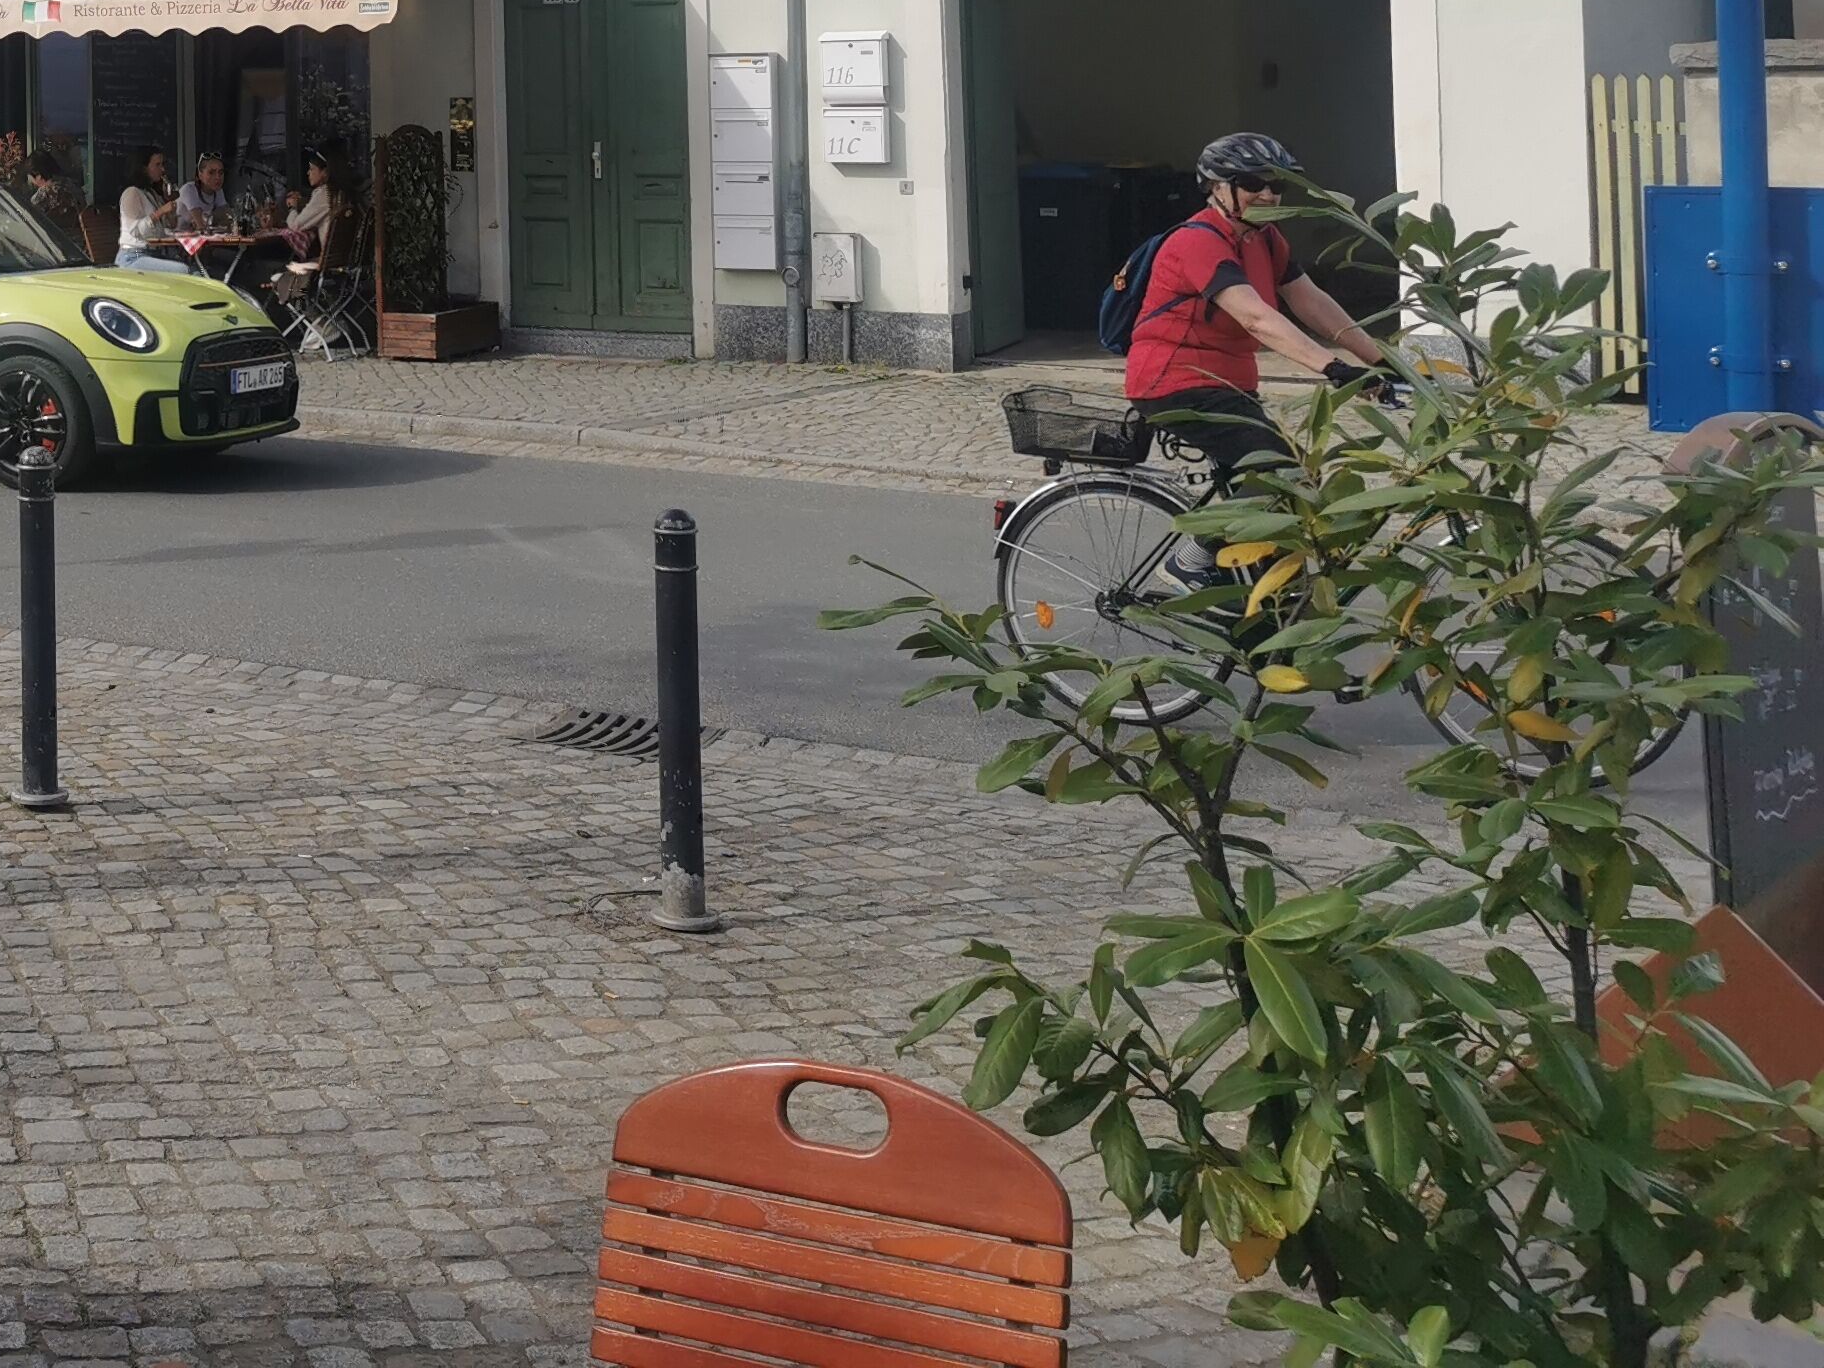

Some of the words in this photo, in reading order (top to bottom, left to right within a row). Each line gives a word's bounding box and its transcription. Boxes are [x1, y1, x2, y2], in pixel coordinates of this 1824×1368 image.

[73, 3, 146, 17] Ristorante
[150, 2, 163, 16] &
[167, 0, 222, 15] Pizzeria
[238, 372, 253, 390] FTL
